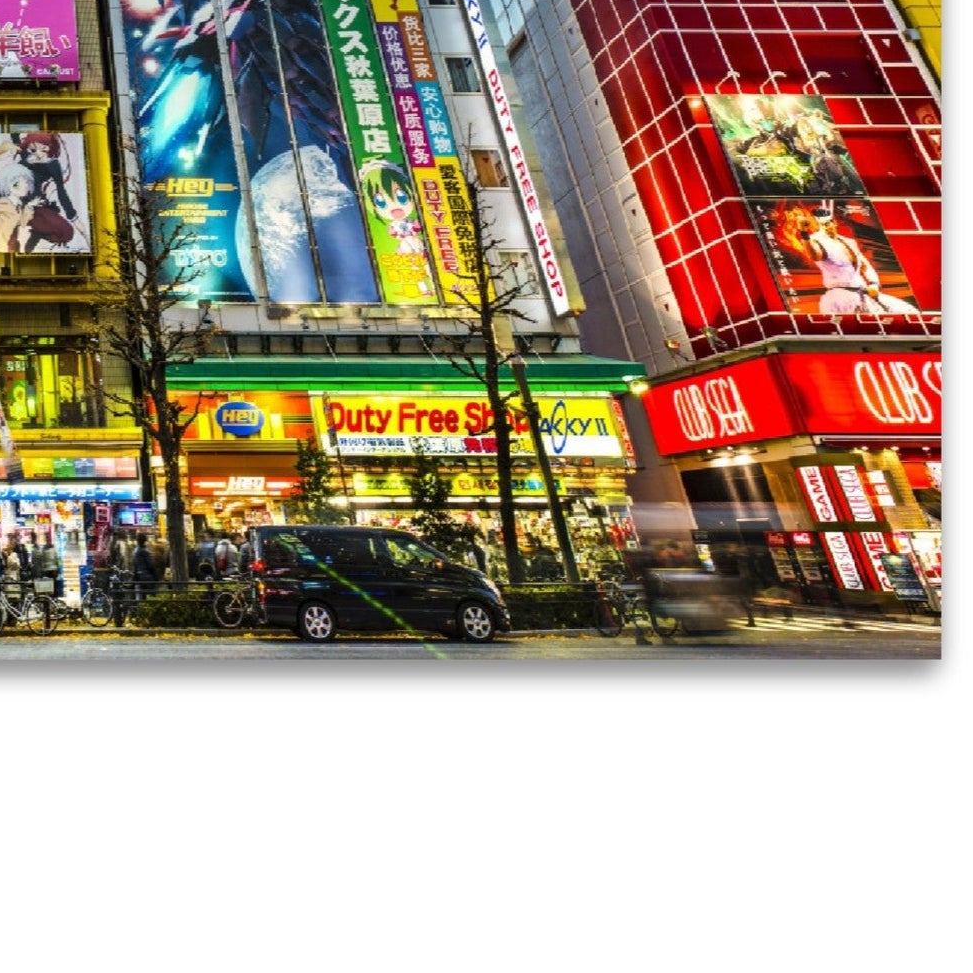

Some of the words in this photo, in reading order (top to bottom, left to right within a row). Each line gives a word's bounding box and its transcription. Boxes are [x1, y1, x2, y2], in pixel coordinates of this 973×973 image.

[166, 179, 214, 197] Hey
[488, 69, 513, 132] DUTY
[511, 146, 539, 214] FREE
[534, 223, 565, 298] SHOP
[422, 180, 445, 223] DUTY
[435, 227, 458, 273] FREE
[222, 409, 259, 426] Hey
[328, 403, 391, 433] Duty
[398, 402, 459, 433] Free
[674, 384, 713, 441] CLUB
[704, 376, 754, 438] SEGA
[854, 361, 933, 423] CLUB
[805, 467, 832, 521] GAME
